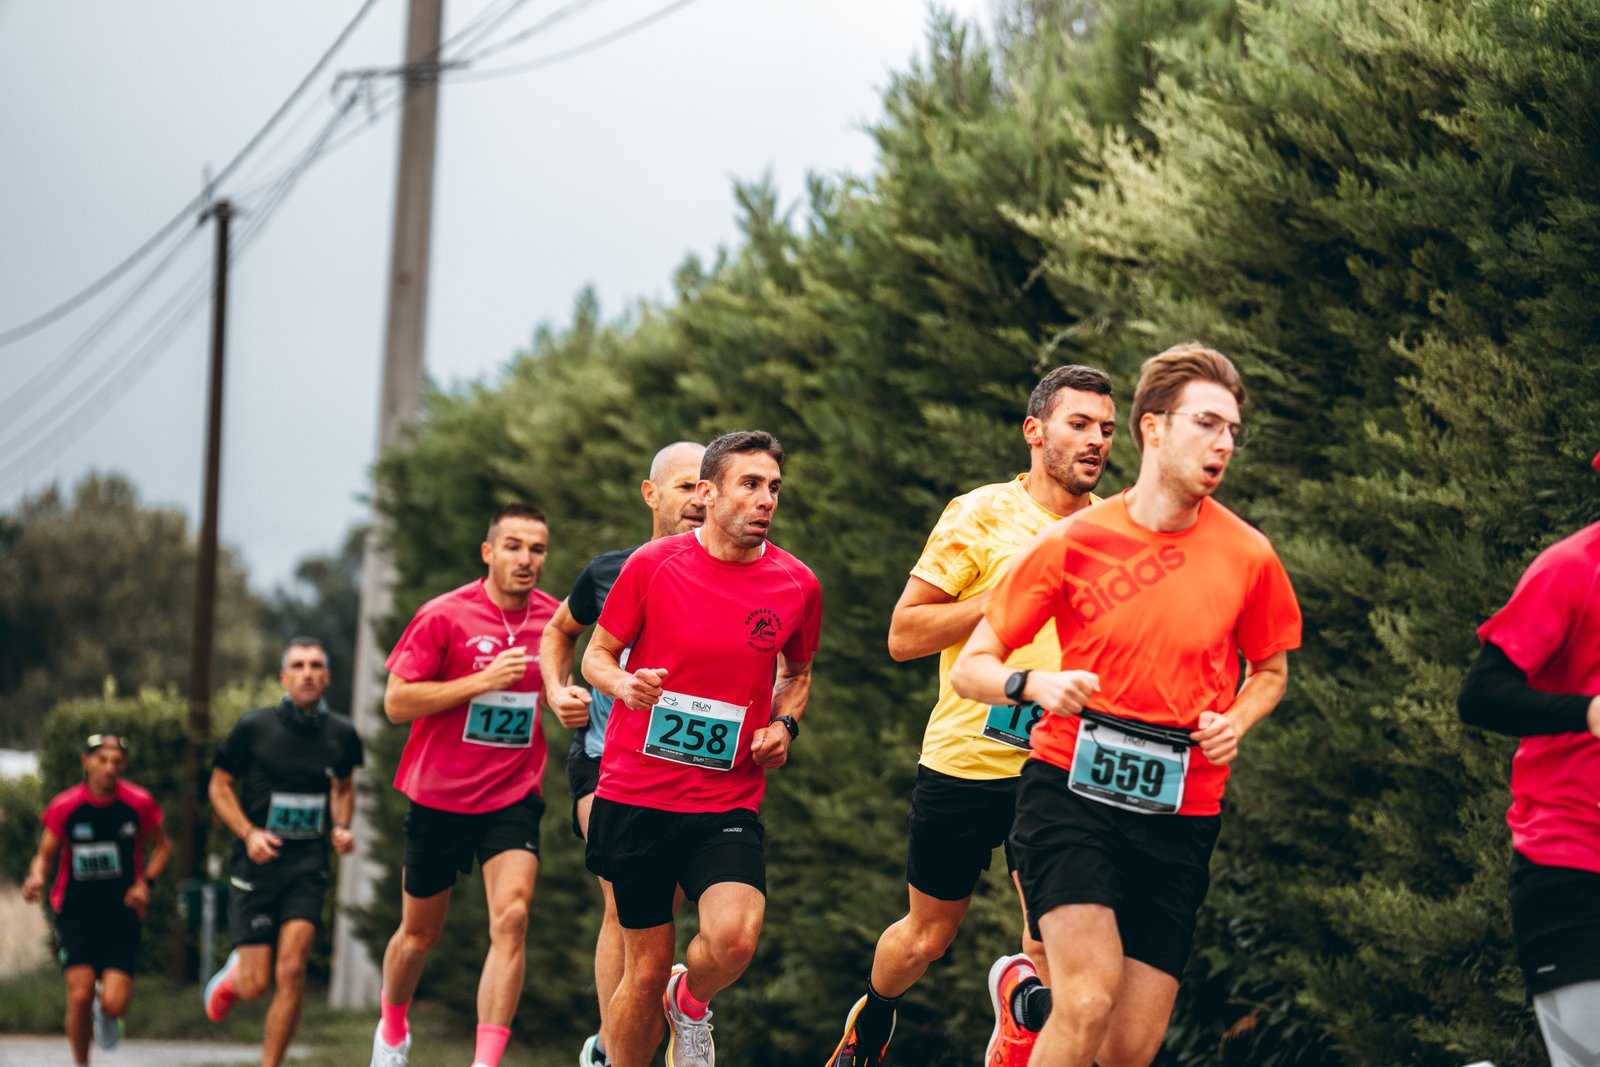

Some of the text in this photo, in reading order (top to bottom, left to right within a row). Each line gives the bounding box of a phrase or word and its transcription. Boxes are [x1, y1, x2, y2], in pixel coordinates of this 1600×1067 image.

[480, 708, 529, 735] 122
[658, 714, 728, 755] 258
[1091, 746, 1166, 797] 559
